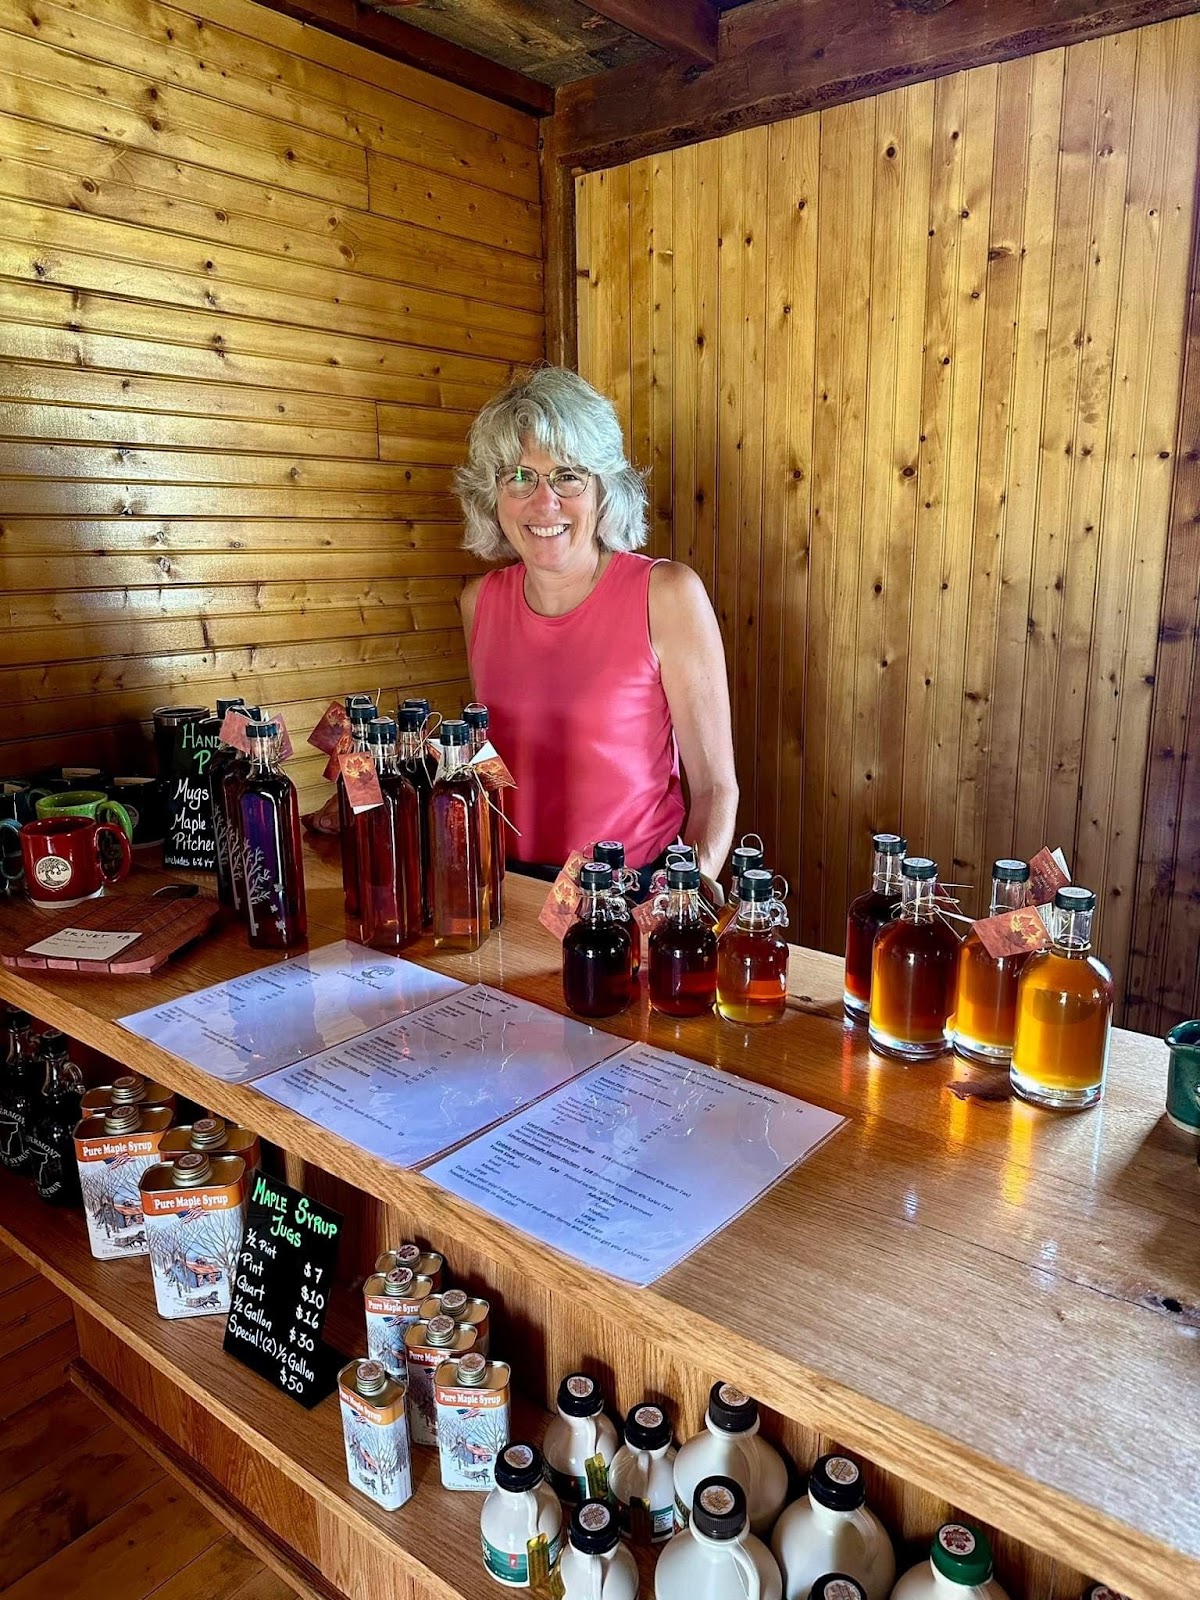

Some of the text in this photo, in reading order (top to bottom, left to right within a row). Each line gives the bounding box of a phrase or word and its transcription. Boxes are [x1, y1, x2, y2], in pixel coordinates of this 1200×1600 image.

[174, 777, 209, 810] Mugs
[170, 807, 206, 834] Maple
[82, 1141, 152, 1157] Pure Maple Syrup
[615, 1182, 638, 1194] Vermont
[647, 1197, 661, 1205] Sales
[634, 1169, 656, 1181] Vermont
[665, 1183, 679, 1191] Sales
[154, 1194, 228, 1209] Pure Maple Syrup
[564, 1173, 582, 1183] Printed
[629, 1204, 653, 1217] Vermont
[258, 1239, 277, 1259] Pint
[303, 1262, 323, 1284] $7
[240, 1252, 324, 1310] Pint $10
[236, 1274, 319, 1329] Quart $16
[368, 1300, 383, 1310] Pure
[383, 1302, 401, 1313] Maple
[243, 1302, 272, 1332] Gallon
[289, 1326, 314, 1351] $30
[288, 1353, 314, 1382] Gallon
[409, 1350, 424, 1361] Pure
[280, 1366, 304, 1393] $50
[440, 1392, 501, 1405] Pure Maple Syrup
[364, 1405, 382, 1423] Syrup
